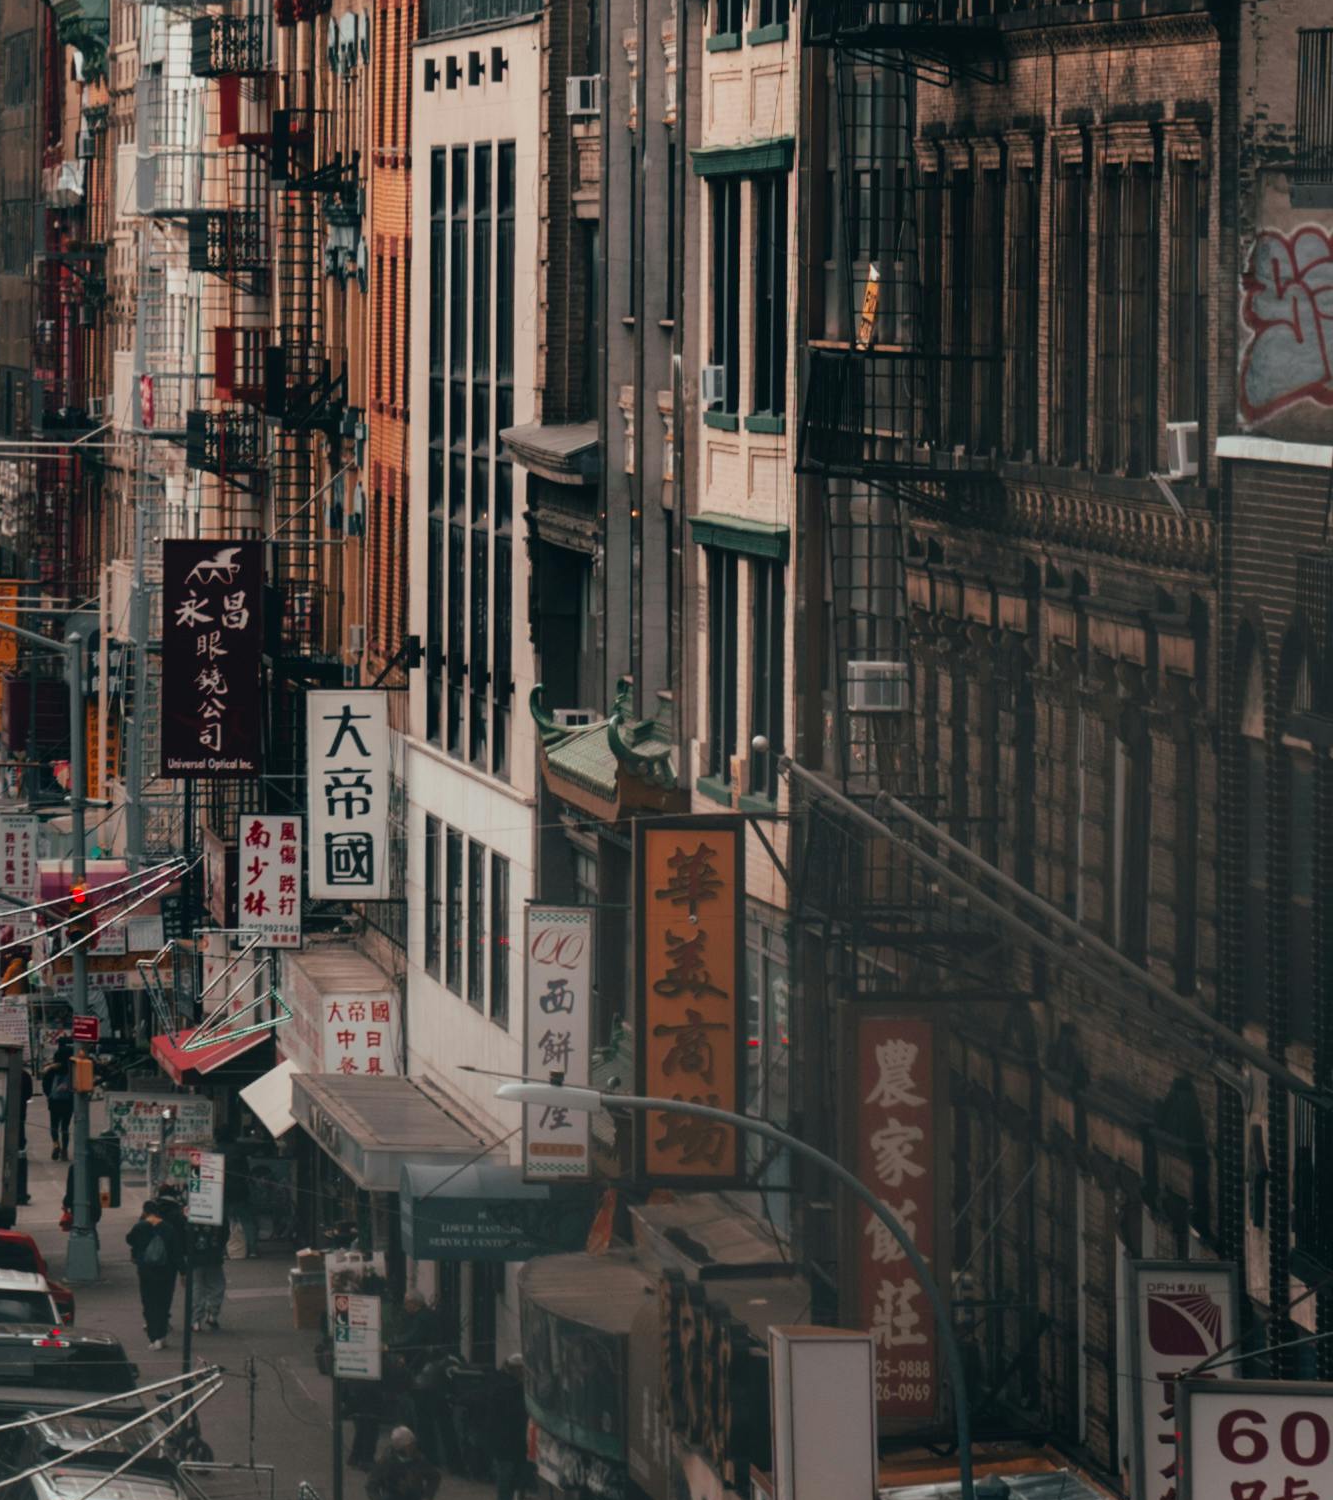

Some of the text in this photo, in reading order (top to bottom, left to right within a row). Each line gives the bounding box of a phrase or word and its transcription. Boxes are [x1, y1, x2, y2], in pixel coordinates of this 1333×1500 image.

[193, 630, 229, 753] 眼鏡公司
[322, 703, 375, 887] 大帝國
[325, 1000, 391, 1024] 大帝國
[1146, 1283, 1175, 1292] DFH
